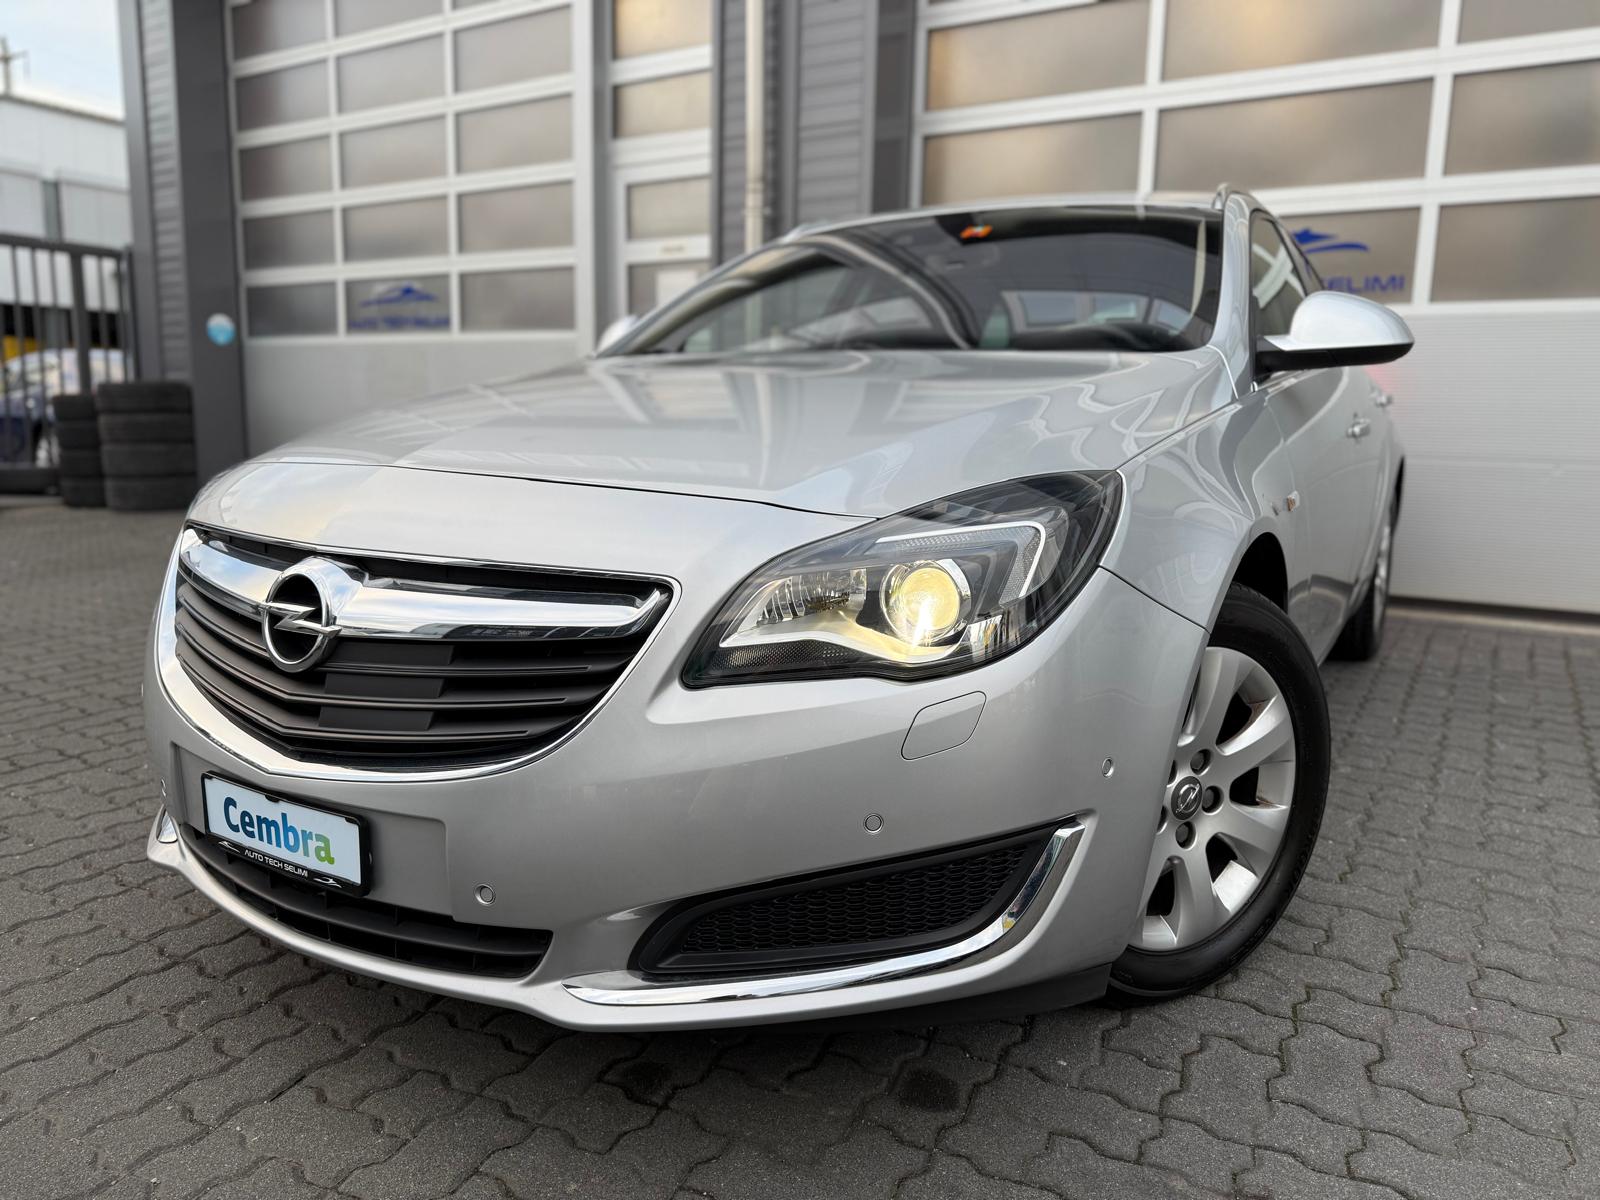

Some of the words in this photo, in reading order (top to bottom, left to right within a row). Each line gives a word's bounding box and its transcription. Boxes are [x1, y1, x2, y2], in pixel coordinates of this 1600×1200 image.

[1321, 273, 1405, 294] ELIMI
[223, 796, 335, 865] Cembra
[244, 849, 264, 862] AUTO
[264, 856, 284, 869] TECH
[283, 863, 309, 878] SELIMI
